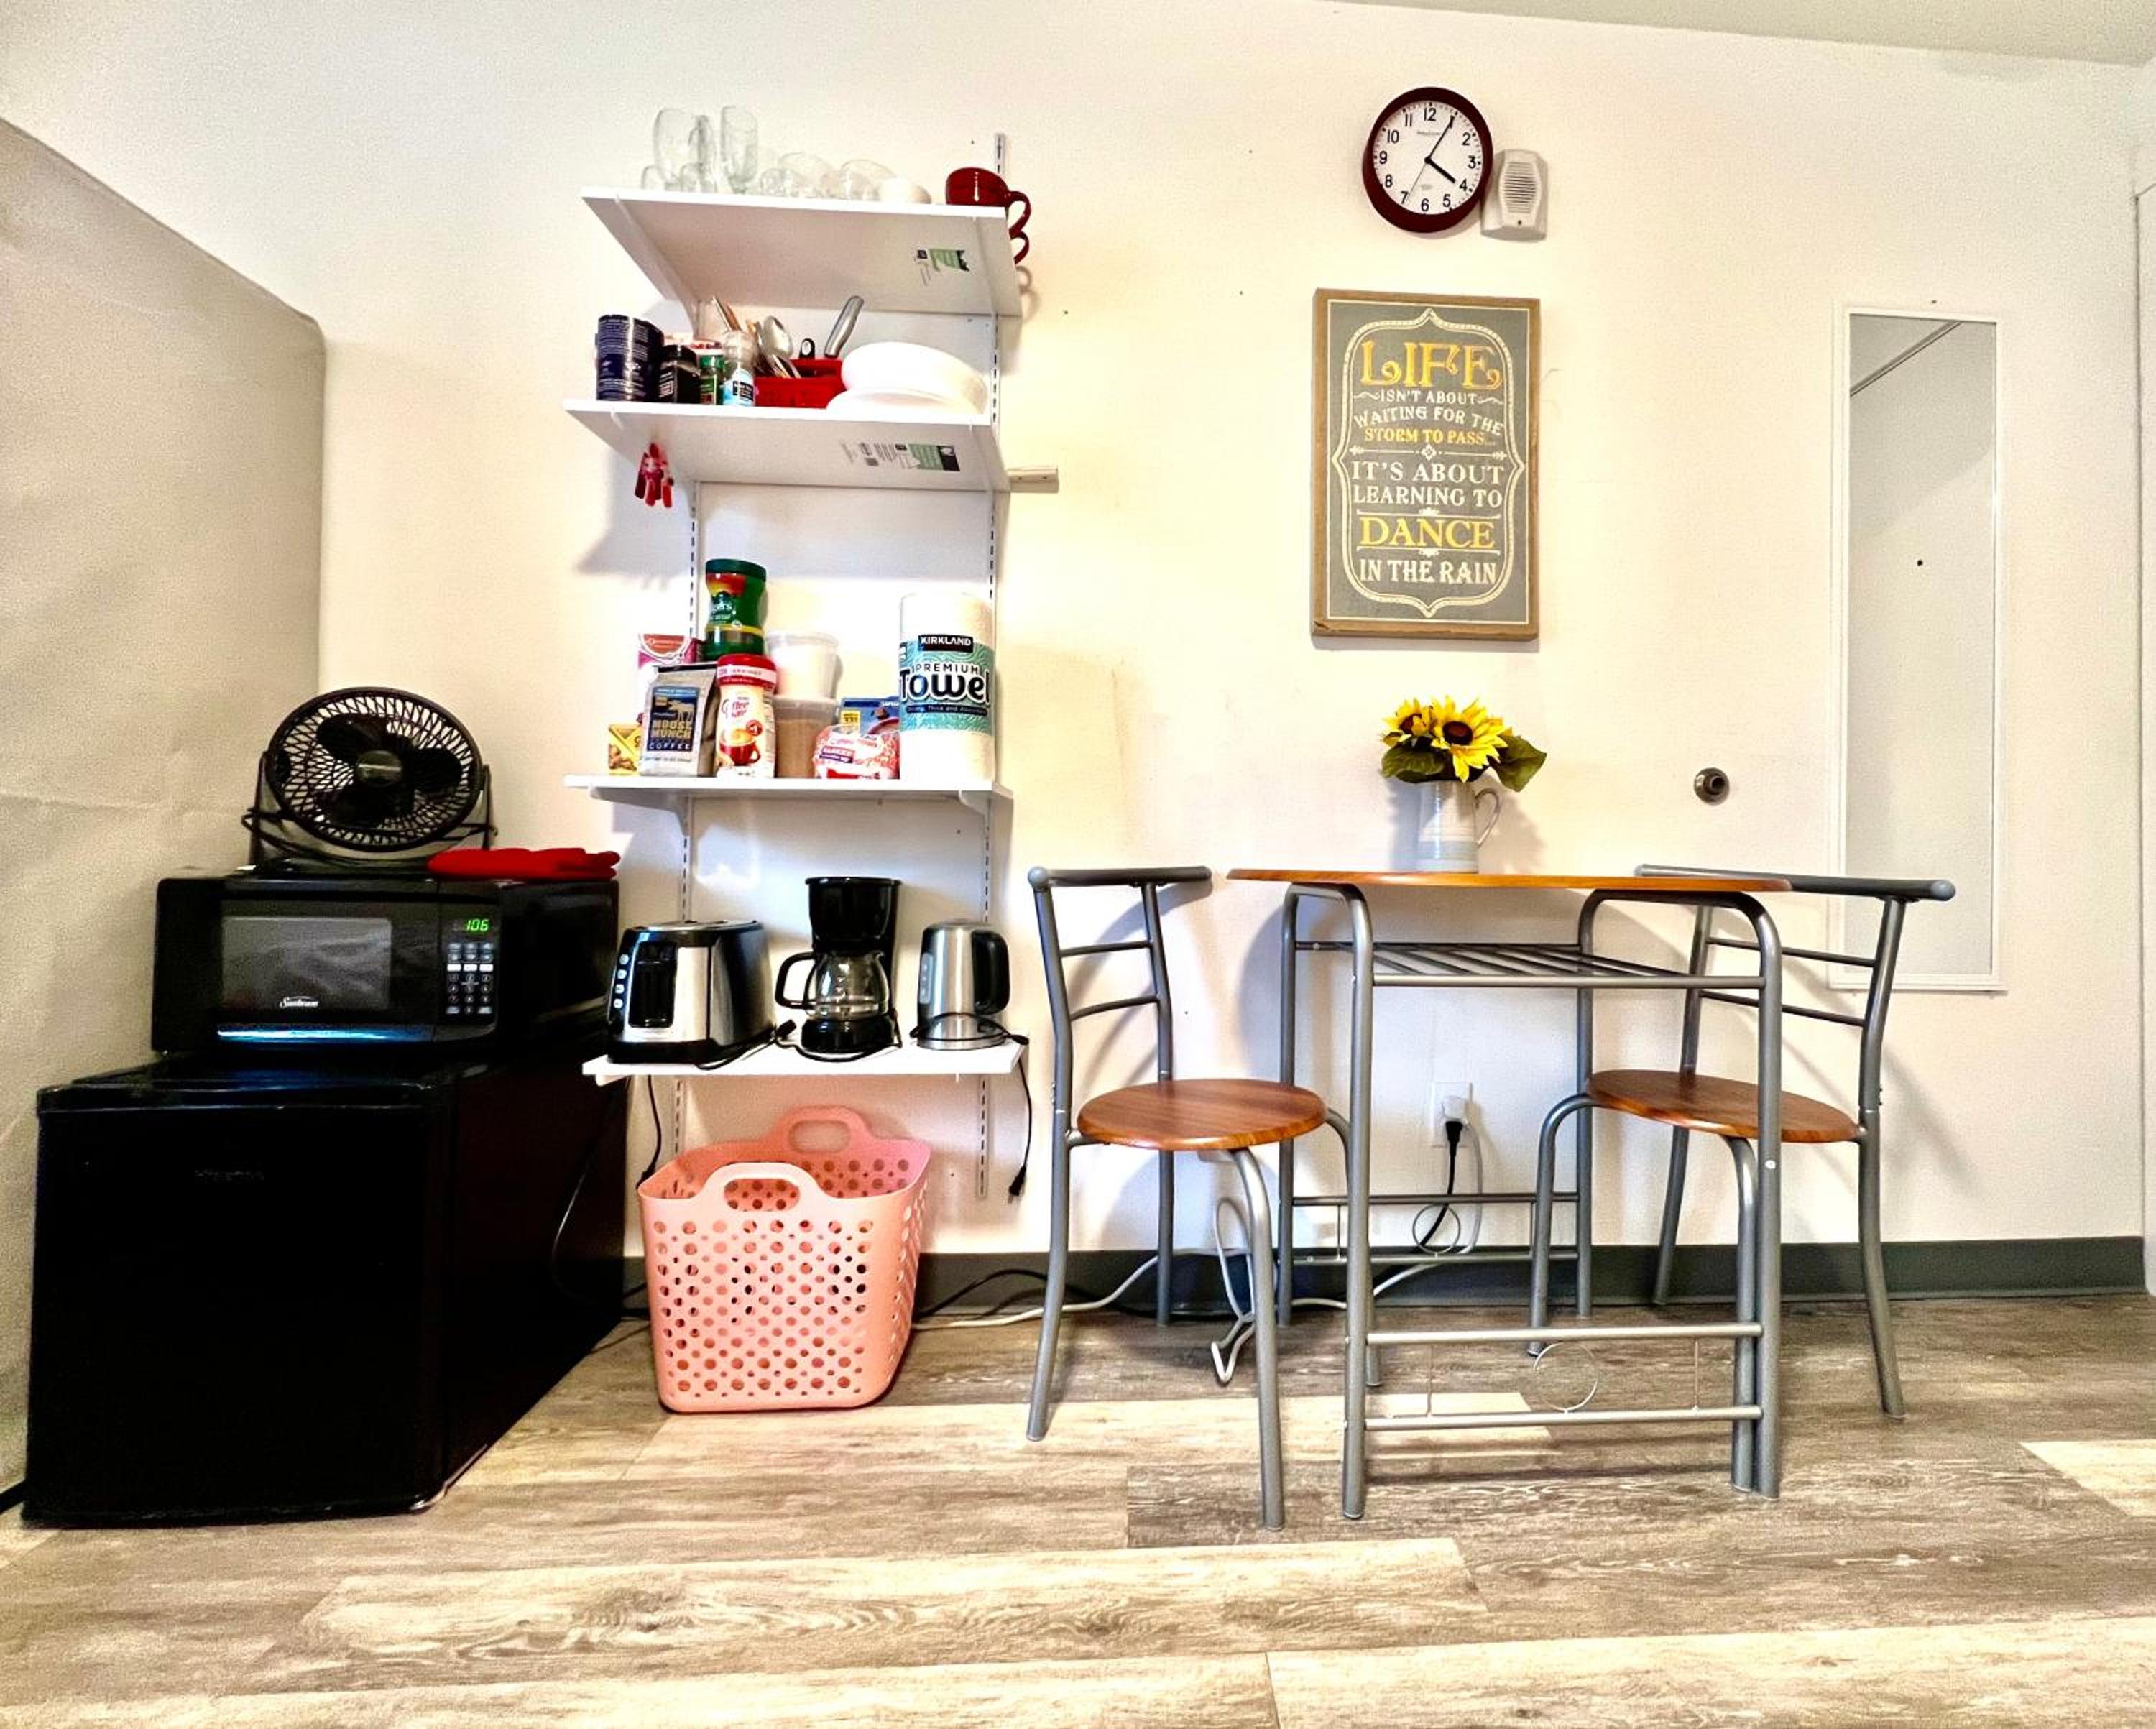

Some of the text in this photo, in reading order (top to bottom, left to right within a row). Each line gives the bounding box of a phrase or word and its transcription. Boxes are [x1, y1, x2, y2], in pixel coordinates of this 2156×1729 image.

[1404, 114, 1412, 127] 11
[1424, 107, 1437, 121] 12
[1387, 130, 1399, 144] 10
[1462, 132, 1471, 146] 2
[1378, 151, 1388, 165] 9
[1468, 155, 1476, 169] 3
[1384, 175, 1393, 188] 8
[1459, 179, 1468, 191] 4
[1401, 191, 1409, 205] 7
[1421, 198, 1429, 212] 6
[1442, 194, 1451, 208] 5
[1360, 339, 1503, 390] LIFE
[1380, 389, 1477, 405] ISN'T ABOUT
[1354, 406, 1504, 436] WAITING FOR THE
[1365, 428, 1418, 443] STORM
[1422, 430, 1443, 443] TO
[1352, 461, 1504, 484] IT'S ABOUT
[1353, 485, 1503, 508] LEARNING TO
[1359, 517, 1495, 548] DANCE
[1360, 559, 1496, 584] IN THE RAIN
[921, 637, 971, 646] KIRKLAND
[915, 663, 978, 674] PREMIUM
[651, 720, 692, 730] MOOSE
[650, 729, 691, 739] MUNCH
[466, 918, 489, 932] 106
